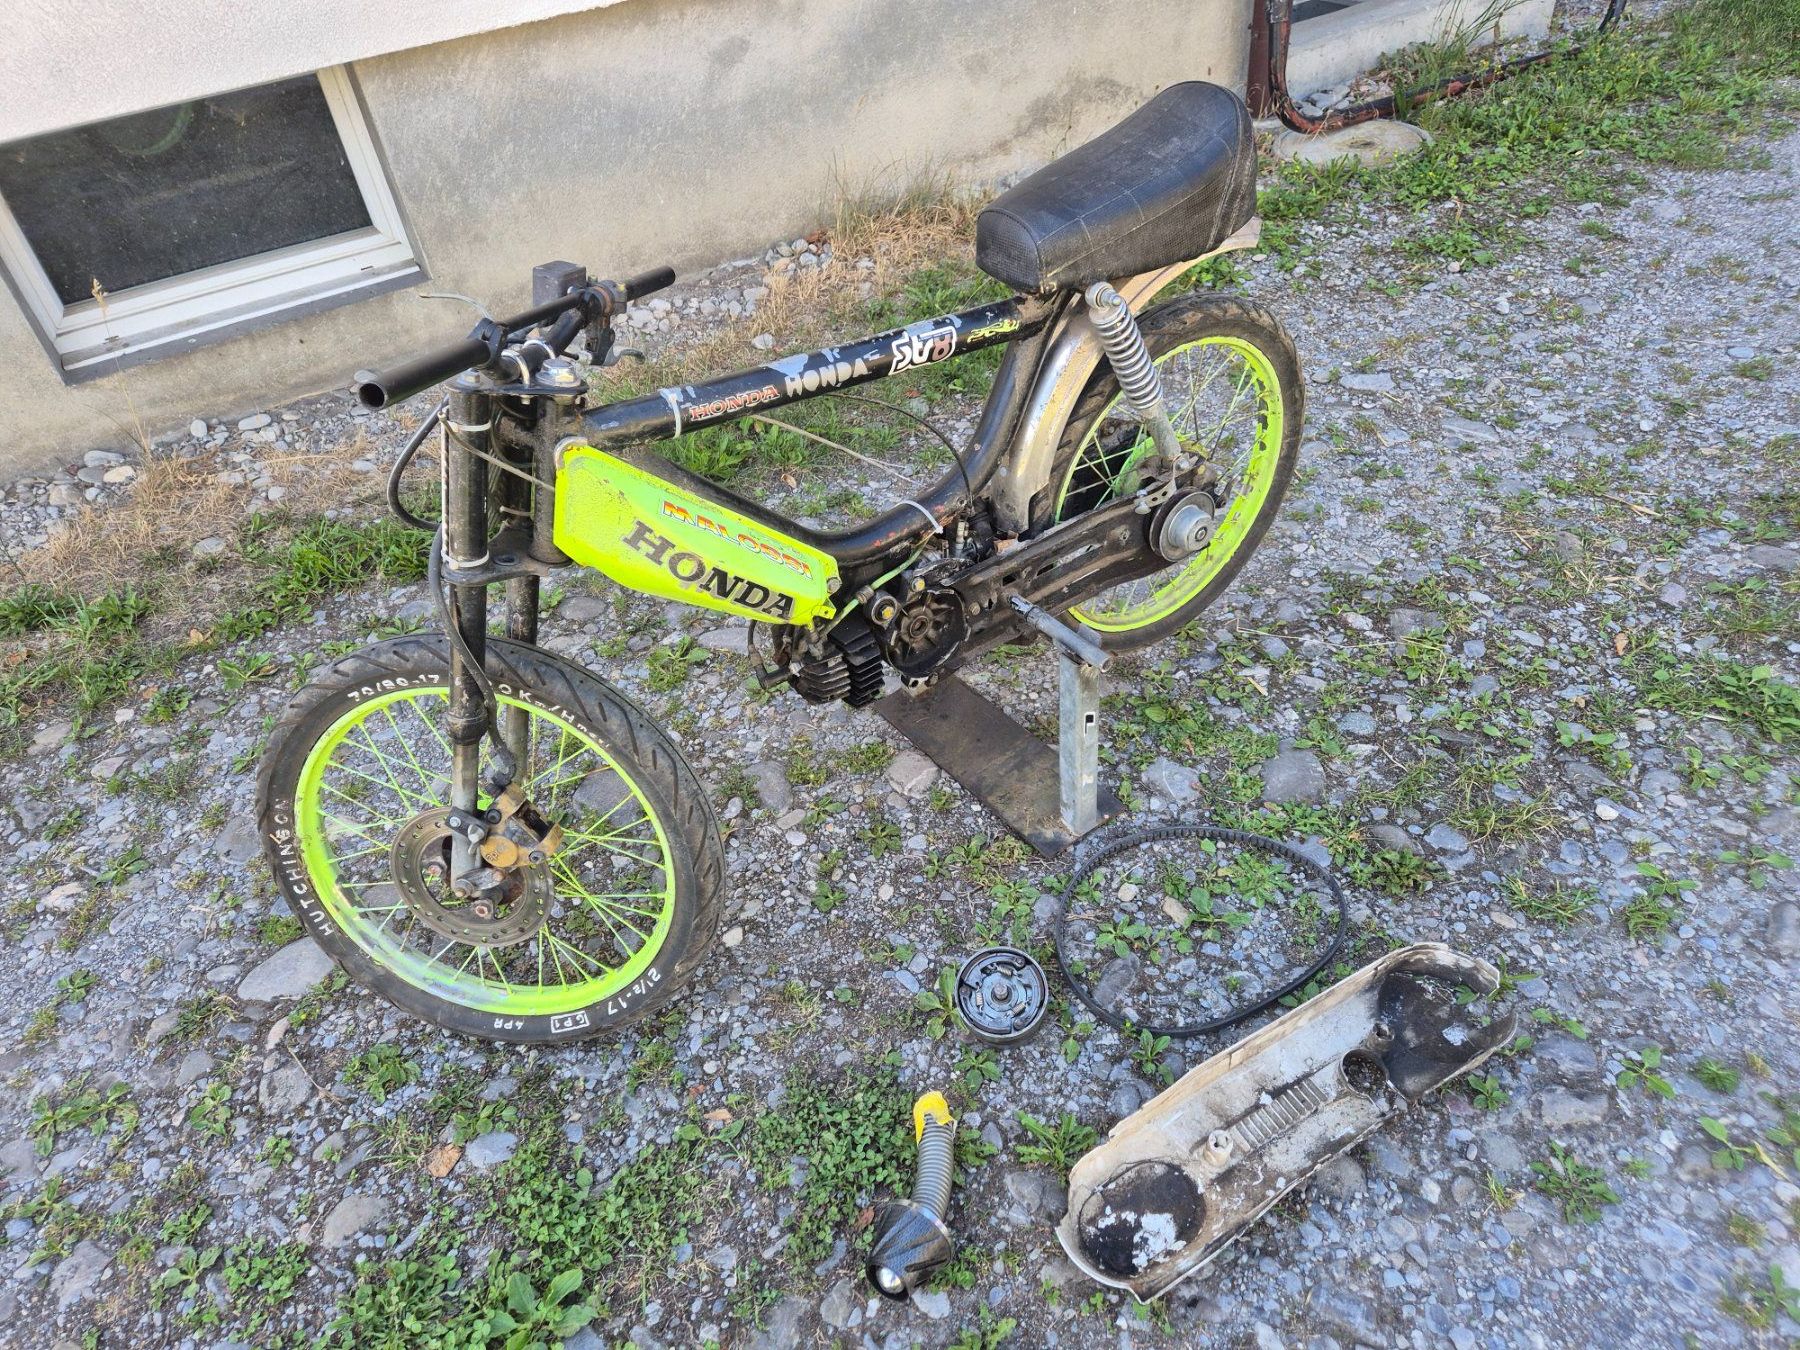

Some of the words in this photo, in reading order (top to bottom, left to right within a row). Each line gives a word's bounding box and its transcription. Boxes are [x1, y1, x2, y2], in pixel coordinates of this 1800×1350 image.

[785, 357, 869, 397] HONDA
[690, 385, 780, 421] HONDA
[662, 500, 813, 580] MALOSSI
[623, 520, 795, 620] HONDA
[494, 1018, 525, 1029] 4PR
